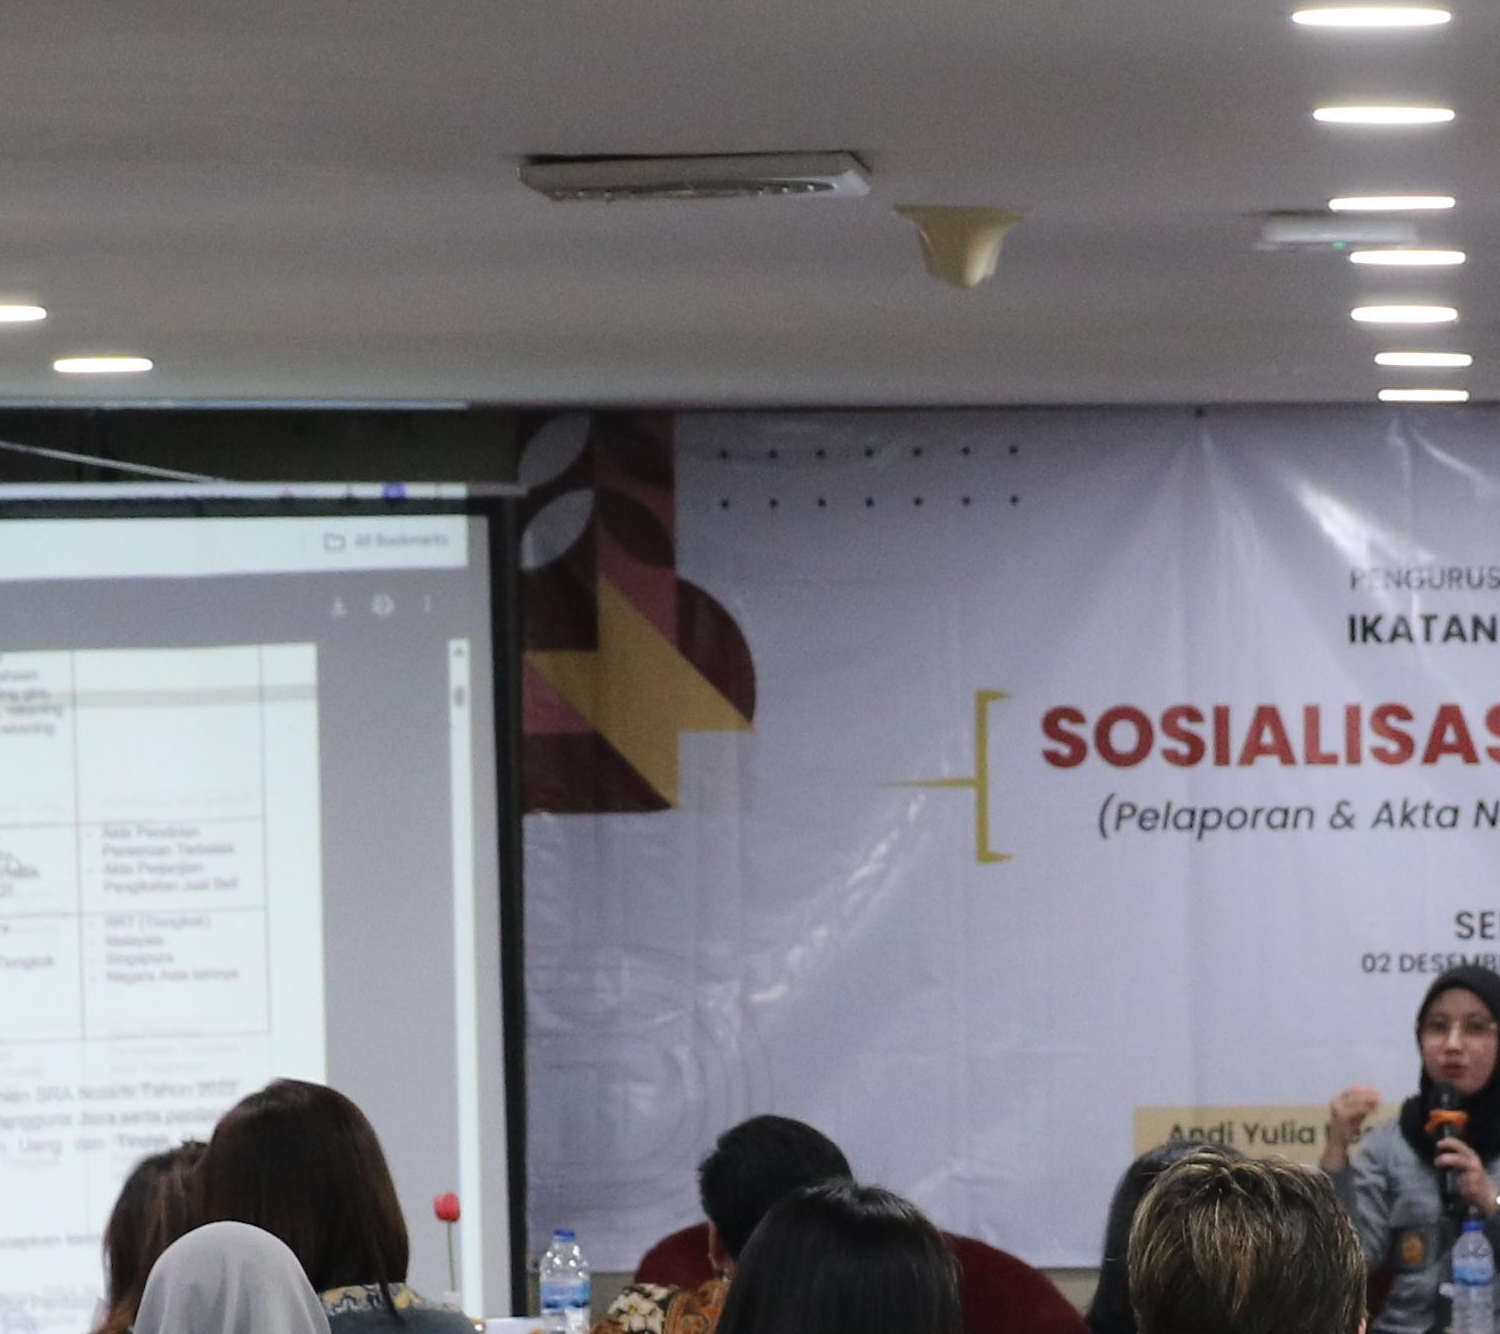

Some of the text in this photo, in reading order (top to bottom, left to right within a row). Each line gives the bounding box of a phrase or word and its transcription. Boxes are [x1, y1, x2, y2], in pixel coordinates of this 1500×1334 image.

[1348, 612, 1498, 644] IKATAN
[1099, 793, 1313, 841] (Pelaporan
[1329, 800, 1355, 829] &
[1372, 798, 1461, 829] Akta
[1361, 953, 1391, 973] 02
[1169, 1122, 1233, 1148] Andi
[1243, 1121, 1315, 1146] Yulia
